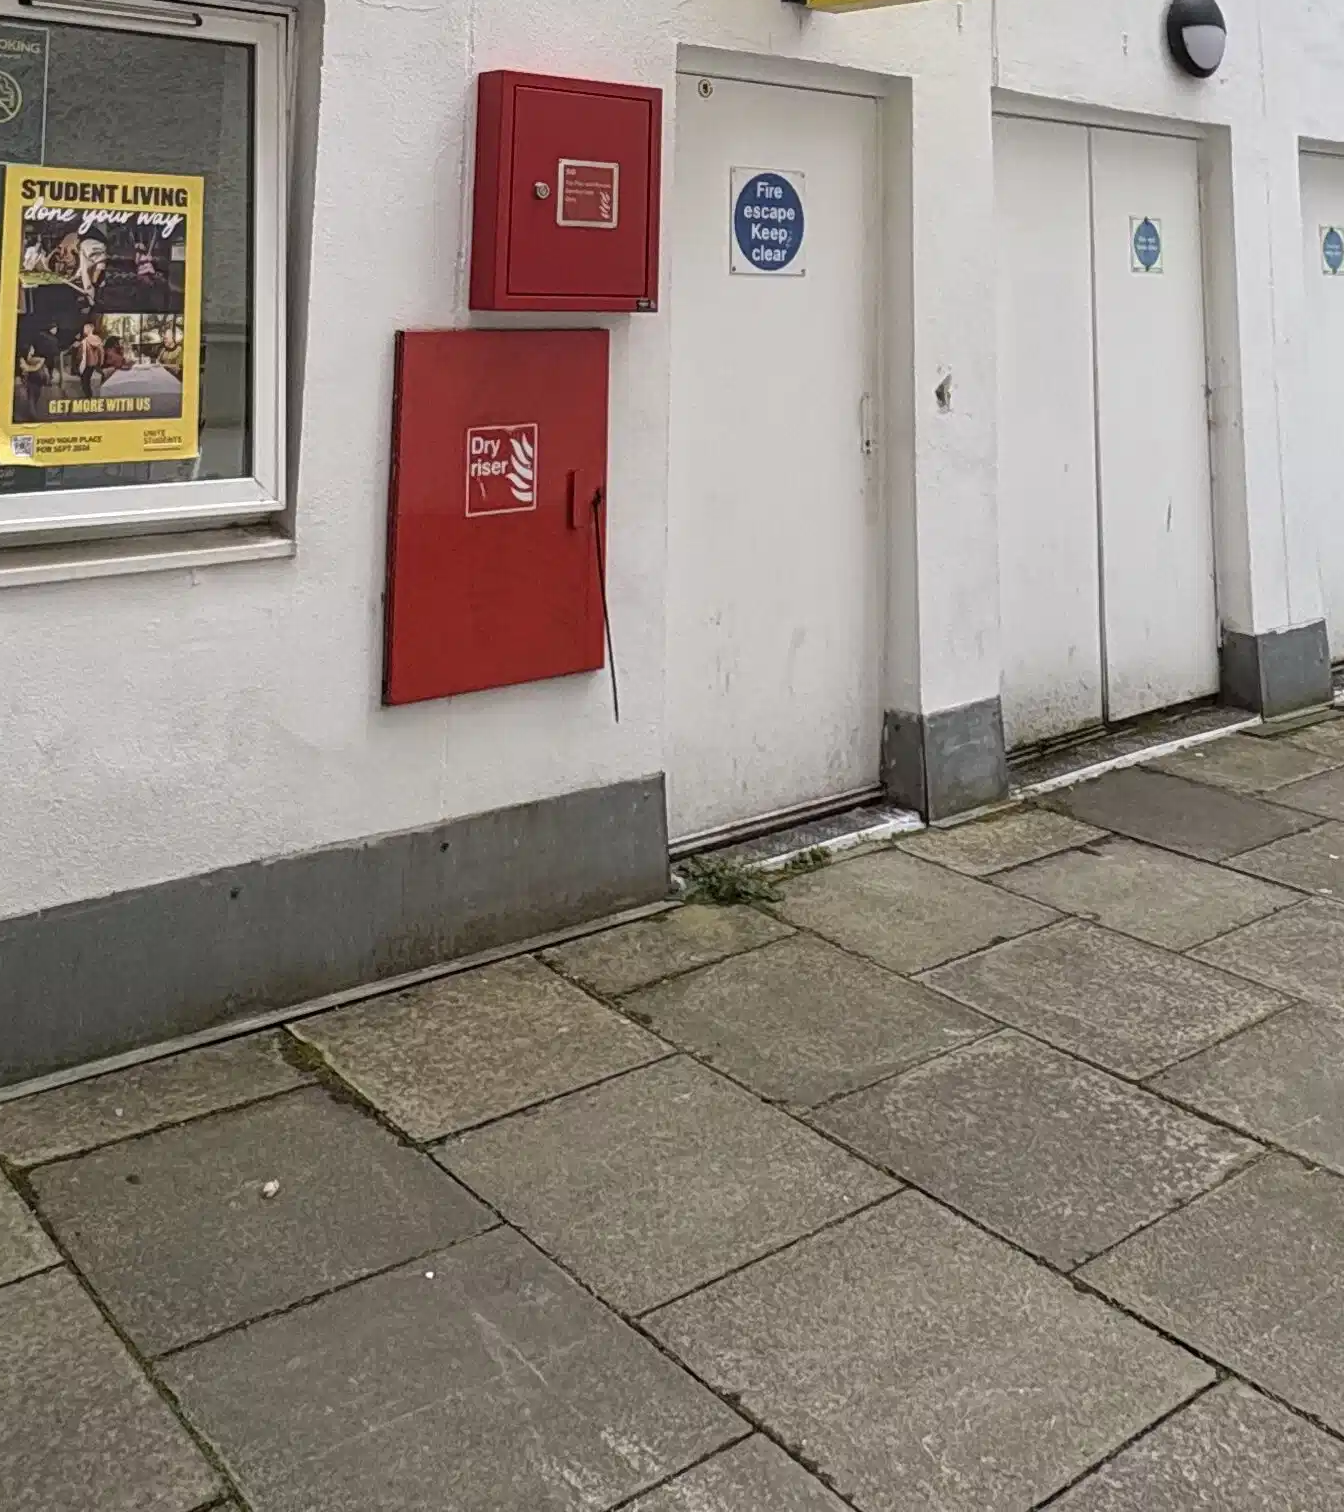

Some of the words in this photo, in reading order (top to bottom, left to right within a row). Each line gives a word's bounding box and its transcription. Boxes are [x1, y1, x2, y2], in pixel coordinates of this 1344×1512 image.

[21, 179, 120, 204] STUDENT
[122, 185, 189, 207] LIVING
[756, 182, 783, 199] Fire
[24, 197, 76, 222] done
[78, 207, 133, 234] your
[137, 211, 184, 238] way
[743, 205, 796, 223] escape
[751, 223, 788, 244] Keep
[752, 245, 787, 261] clear
[48, 400, 71, 414] GET
[72, 398, 105, 413] MORE
[106, 398, 135, 412] WITH
[136, 397, 151, 412] US
[471, 436, 501, 459] Dry
[471, 458, 509, 477] riser
